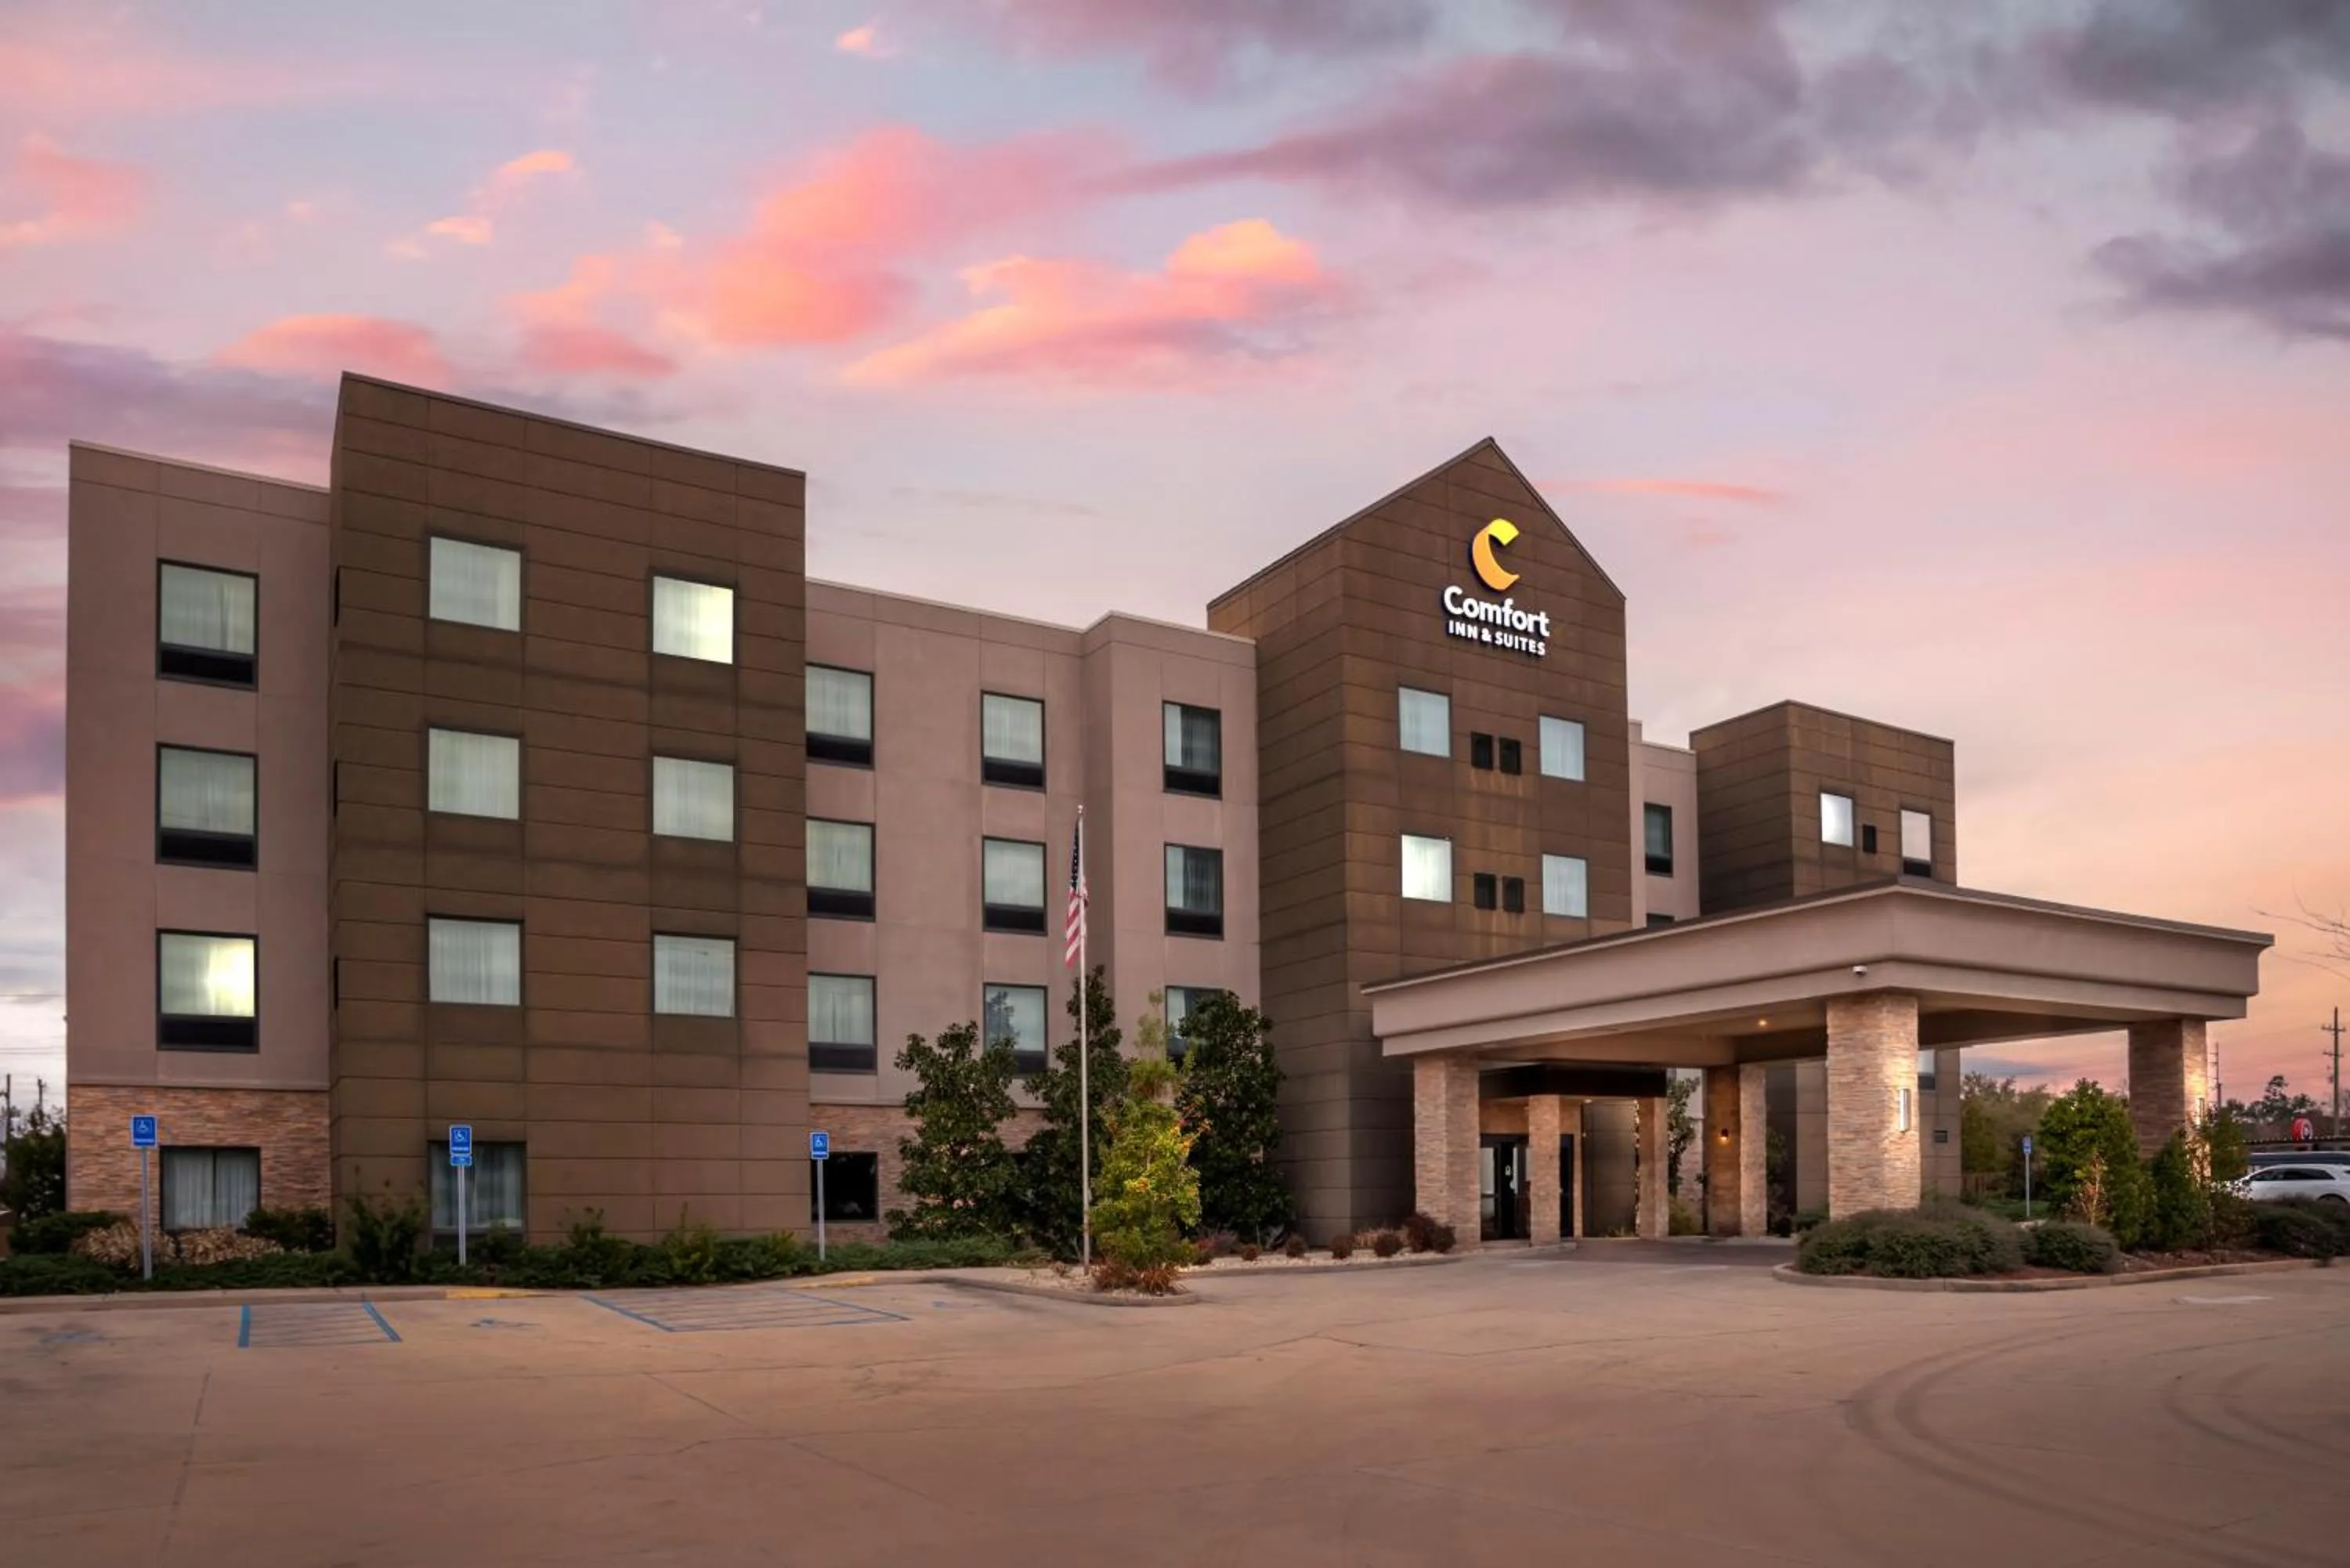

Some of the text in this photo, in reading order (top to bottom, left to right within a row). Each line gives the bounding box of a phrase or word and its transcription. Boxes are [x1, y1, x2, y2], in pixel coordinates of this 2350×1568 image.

[1444, 585, 1550, 637] Comfort
[1448, 620, 1546, 656] INN & SUITES
